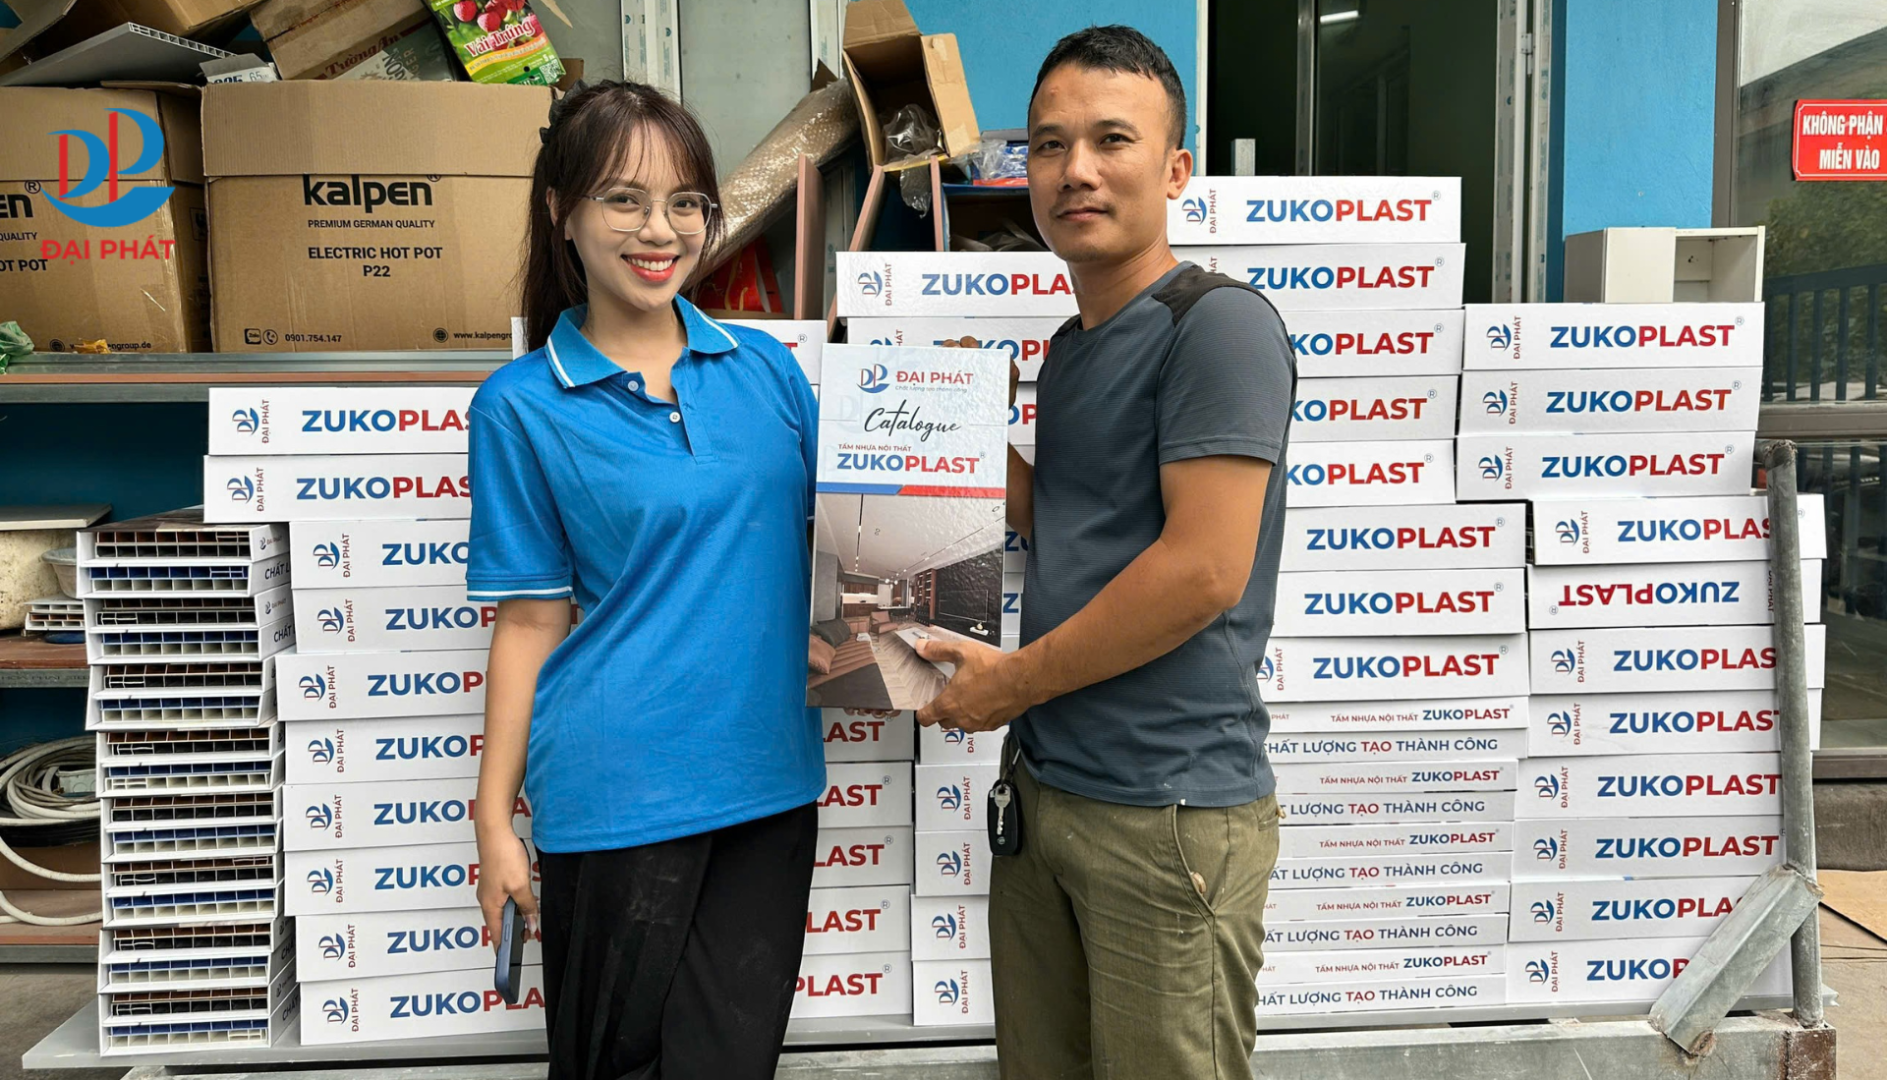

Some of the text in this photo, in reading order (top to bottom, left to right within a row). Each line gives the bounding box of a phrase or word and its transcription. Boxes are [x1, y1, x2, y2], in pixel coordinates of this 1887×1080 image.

[1802, 110, 1845, 135] KHÔNG
[1849, 110, 1883, 140] PHẬN
[1819, 142, 1880, 170] MIỄN VÀO
[1208, 189, 1216, 214] PHÁT
[1246, 199, 1432, 222] ZUKOPLAST
[308, 220, 435, 230] PREMIUM GERMAN QUALITY
[308, 247, 443, 259] ELECTRIC HOT POT
[18, 259, 48, 272] POT
[363, 265, 391, 278] P22
[883, 263, 893, 306] ĐẠI PHÁT
[922, 273, 1079, 296] ZUKOPLA
[1247, 266, 1435, 290] ZUKOPLAST
[284, 333, 342, 343] 0901.754.147
[1513, 316, 1521, 359] ĐẠI PHÁT
[1550, 325, 1735, 348] ZUKOPLAST
[895, 369, 974, 386] ĐẠI PHÁT
[1509, 382, 1518, 424] ĐẠI PHÁT
[1546, 389, 1732, 413] ZUKOPLAST
[260, 400, 270, 444] ĐẠI PHÁT
[864, 399, 962, 443] Catalogue
[838, 443, 855, 451] TẤM
[855, 443, 877, 452] NHỰA
[893, 444, 912, 452] THẤT
[837, 453, 980, 474] ZUKOPLAST
[1504, 447, 1513, 489] ĐẠI PHÁT
[1542, 454, 1725, 478] ZUKOPLAST
[255, 467, 265, 512] ĐẠI PHÁT
[1580, 511, 1588, 534] PHÁT
[1307, 526, 1496, 550] ZUKOPLAST
[341, 533, 351, 578] ĐẠI PHÁT
[1304, 591, 1494, 614] ZUKOPLAST
[1558, 581, 1740, 606] ZUKOPLAST
[344, 599, 356, 642] ĐẠI PHÁT
[1275, 647, 1285, 691] ĐẠI PHÁT
[1313, 654, 1499, 679] ZUKOPLAST
[1576, 641, 1585, 683] ĐẠI PHÁT
[326, 665, 337, 709] ĐẠI PHÁT
[1331, 708, 1510, 723] TẤM NHỰA NỘI THẤT ZUKOPLAST
[1573, 703, 1582, 725] PHÁT
[335, 729, 345, 773] ĐẠI PHÁT
[967, 737, 975, 753] ĐẠI
[1303, 737, 1497, 755] LƯỢNG TẠO THÀNH CÔNG
[1320, 776, 1338, 784] TẤM
[1368, 776, 1383, 784] NỘI
[1385, 775, 1407, 783] THẤT
[1412, 770, 1500, 782] ZUKOPLAST
[1560, 766, 1569, 808] ĐẠI PHÁT
[962, 776, 972, 820] ĐẠI PHÁT
[1291, 802, 1344, 817] LƯỢNG
[1348, 803, 1379, 816] TẠO
[1383, 800, 1436, 813] THÀNH
[1441, 799, 1484, 812] CÔNG
[333, 795, 343, 838] ĐẠI PHÁT
[1319, 832, 1495, 848] TẤM NHỰA NỘI THẤT ZUKOPLAST
[1559, 829, 1567, 869] ĐẠI PHÁT
[1595, 835, 1779, 859] ZUKOPLAST
[962, 842, 973, 885] ĐẠI PHÁT
[1293, 862, 1482, 881] LƯỢNG TẠO THÀNH CÔNG
[335, 859, 344, 903] ĐẠI PHÁT
[1363, 901, 1378, 910] NỘI
[1380, 900, 1402, 908] THẤT
[1406, 894, 1491, 907] ZUKOPLAST
[1556, 892, 1564, 932] ĐẠI PHÁT
[957, 905, 967, 949] ĐẠI PHÁT
[1288, 924, 1477, 944] LƯỢNG TẠO THÀNH CÔNG
[347, 924, 356, 968] ĐẠI PHÁT
[1315, 955, 1488, 973] TẤM NHỰA NỘI THẤT ZUKOPLAST
[1550, 951, 1559, 992] ĐẠI PHÁT
[960, 970, 968, 994] PHÁT
[1290, 984, 1477, 1006] LƯỢNG TẠO THÀNH CÔNG
[350, 988, 360, 1032] ĐẠI PHÁT
